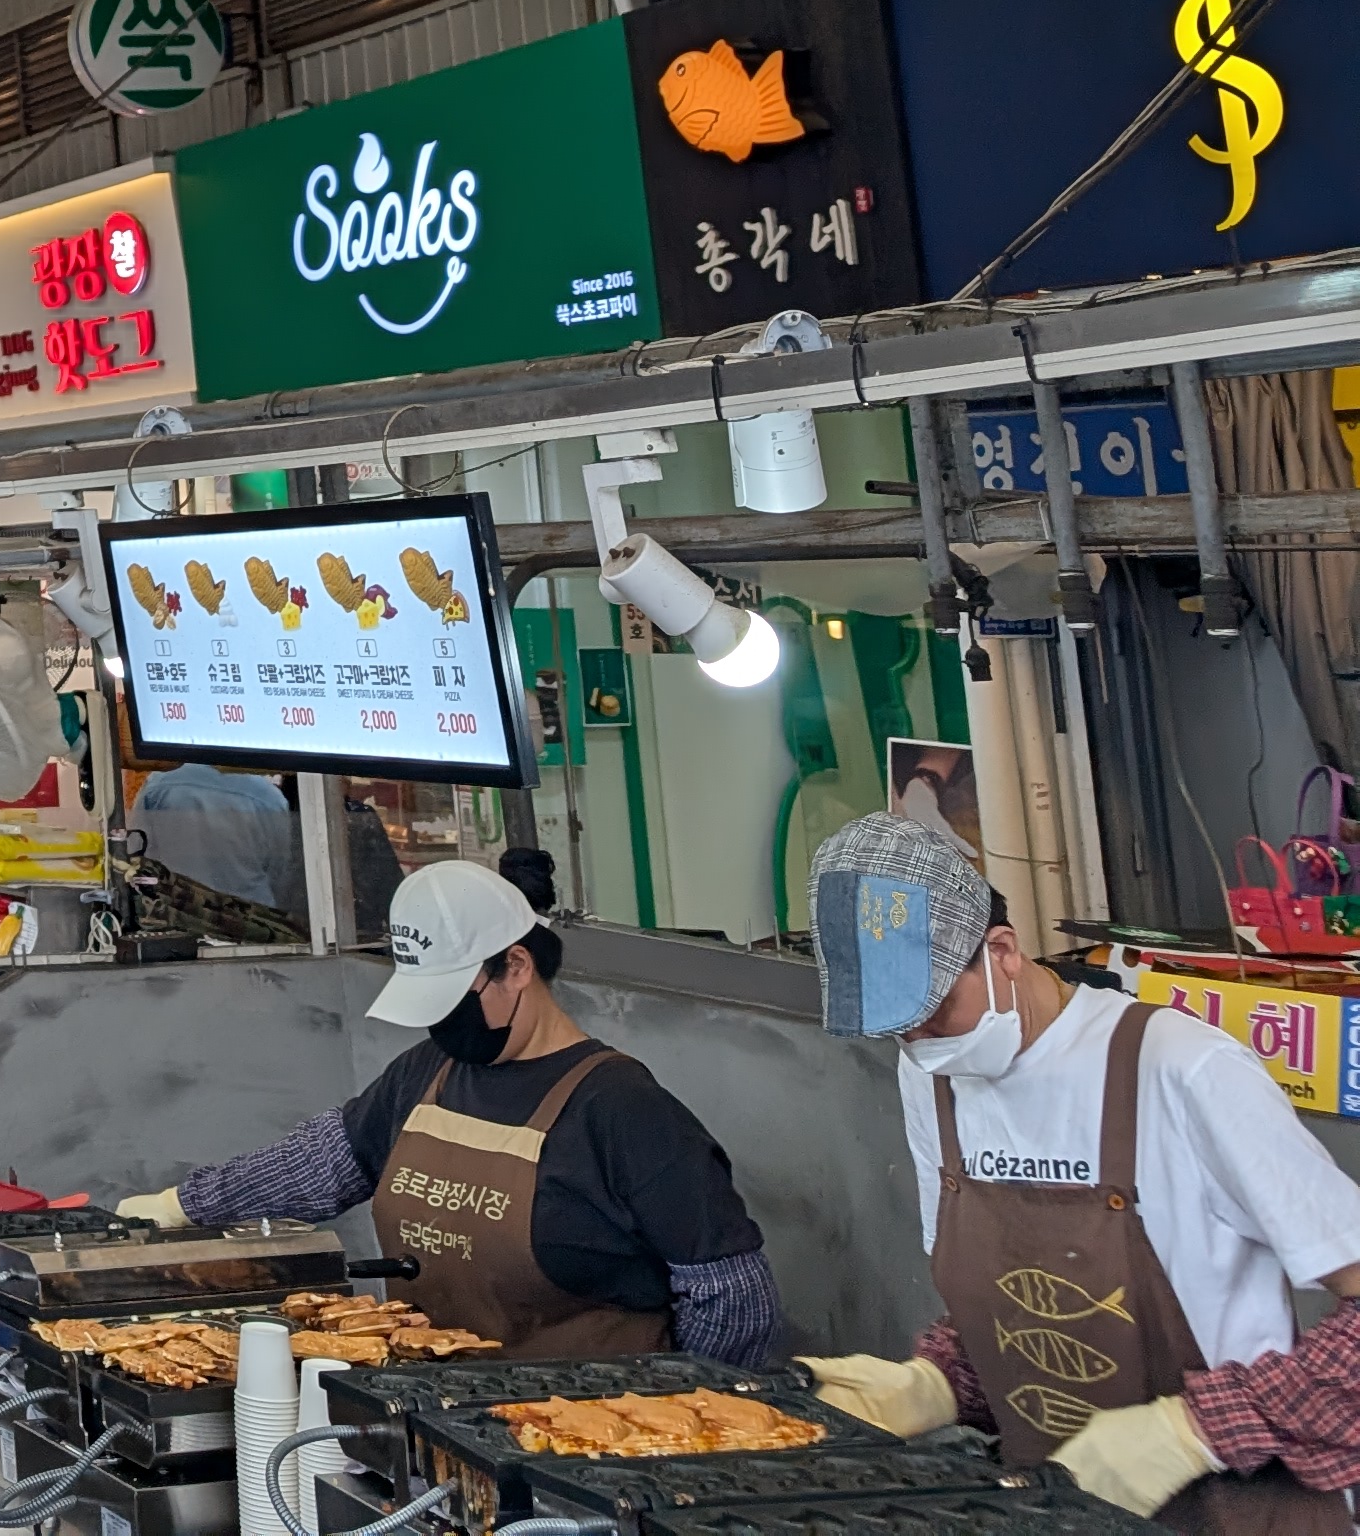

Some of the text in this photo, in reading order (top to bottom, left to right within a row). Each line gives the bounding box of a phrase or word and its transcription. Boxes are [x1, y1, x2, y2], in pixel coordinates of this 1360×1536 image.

[293, 139, 479, 283] Sooks
[694, 196, 860, 295] 총각네
[30, 226, 106, 310] 광장
[571, 270, 634, 296] Since 2016
[43, 309, 166, 395] 핫도그
[146, 662, 188, 682] 단팥+호두
[208, 664, 243, 683] 슈크림
[257, 663, 327, 686] 단팥+크림치즈
[333, 664, 412, 687] 고구마+크림치즈
[432, 665, 467, 688] 피자
[160, 702, 186, 722] 1,500
[217, 704, 245, 724] 1,500
[281, 706, 315, 728] 2,000
[360, 710, 397, 731] 2,000
[437, 713, 478, 735] 2,000
[980, 1150, 1091, 1181] Cézanne
[389, 1166, 511, 1221] 종로광장시장
[399, 1218, 473, 1261] 두근두근마켓
